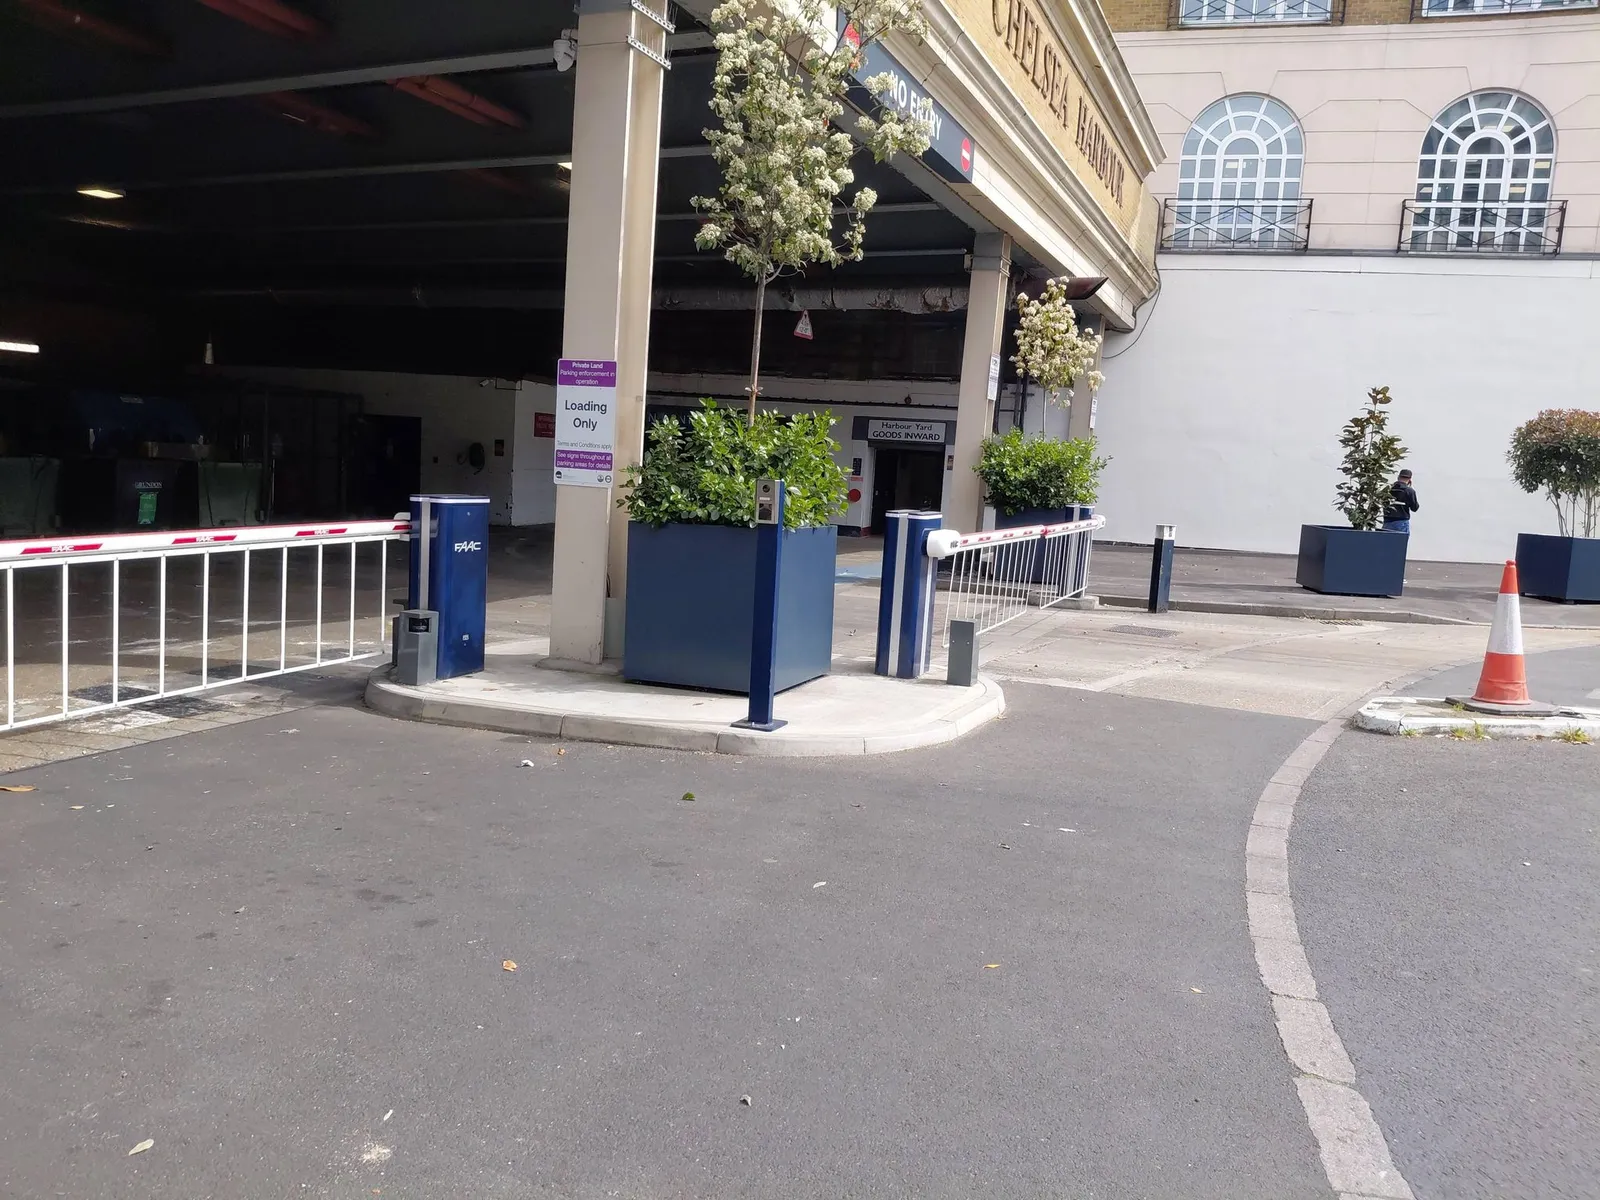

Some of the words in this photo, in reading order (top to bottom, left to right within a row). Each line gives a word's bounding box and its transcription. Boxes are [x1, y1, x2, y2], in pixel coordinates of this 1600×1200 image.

[890, 69, 907, 108] NO
[992, 0, 1070, 130] CHELSEA
[1075, 96, 1125, 209] HARBOUR
[560, 369, 578, 377] Parking
[565, 400, 607, 415] Loading
[573, 417, 597, 431] Only
[882, 422, 911, 430] Harbour
[873, 430, 902, 439] GOODS
[904, 432, 940, 440] INWARD
[601, 443, 613, 451] apply
[580, 453, 606, 461] throughout
[556, 460, 575, 468] parking
[454, 540, 481, 552] FAAC
